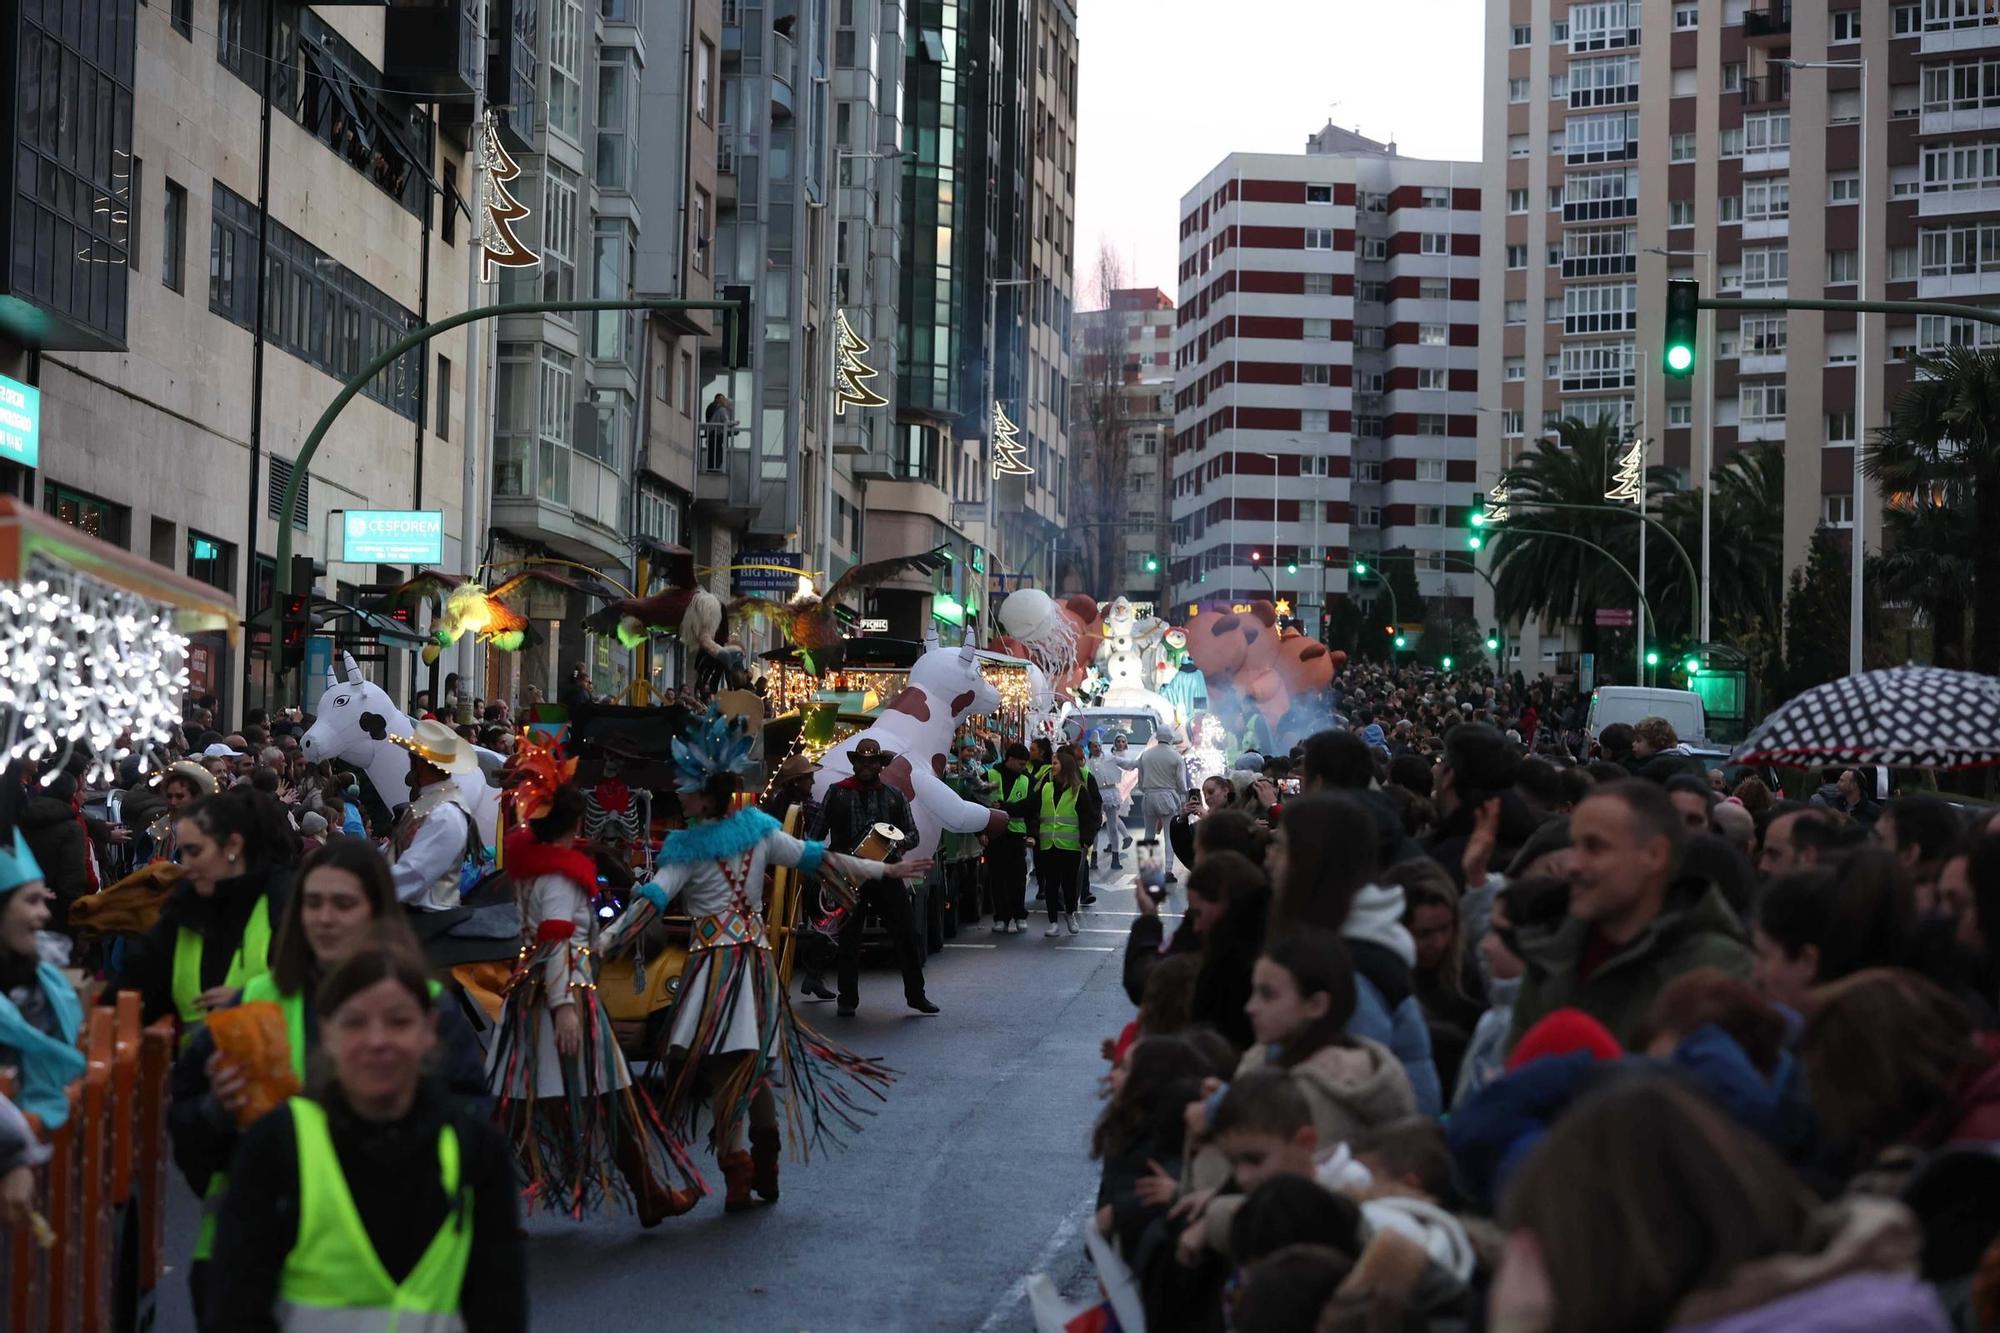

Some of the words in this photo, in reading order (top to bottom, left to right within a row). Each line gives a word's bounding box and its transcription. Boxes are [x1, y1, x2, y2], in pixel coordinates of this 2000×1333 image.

[368, 520, 440, 533] CESFOREM
[742, 556, 791, 567] CHINO'S
[740, 567, 761, 577] BIG
[860, 620, 887, 629] PICNIC
